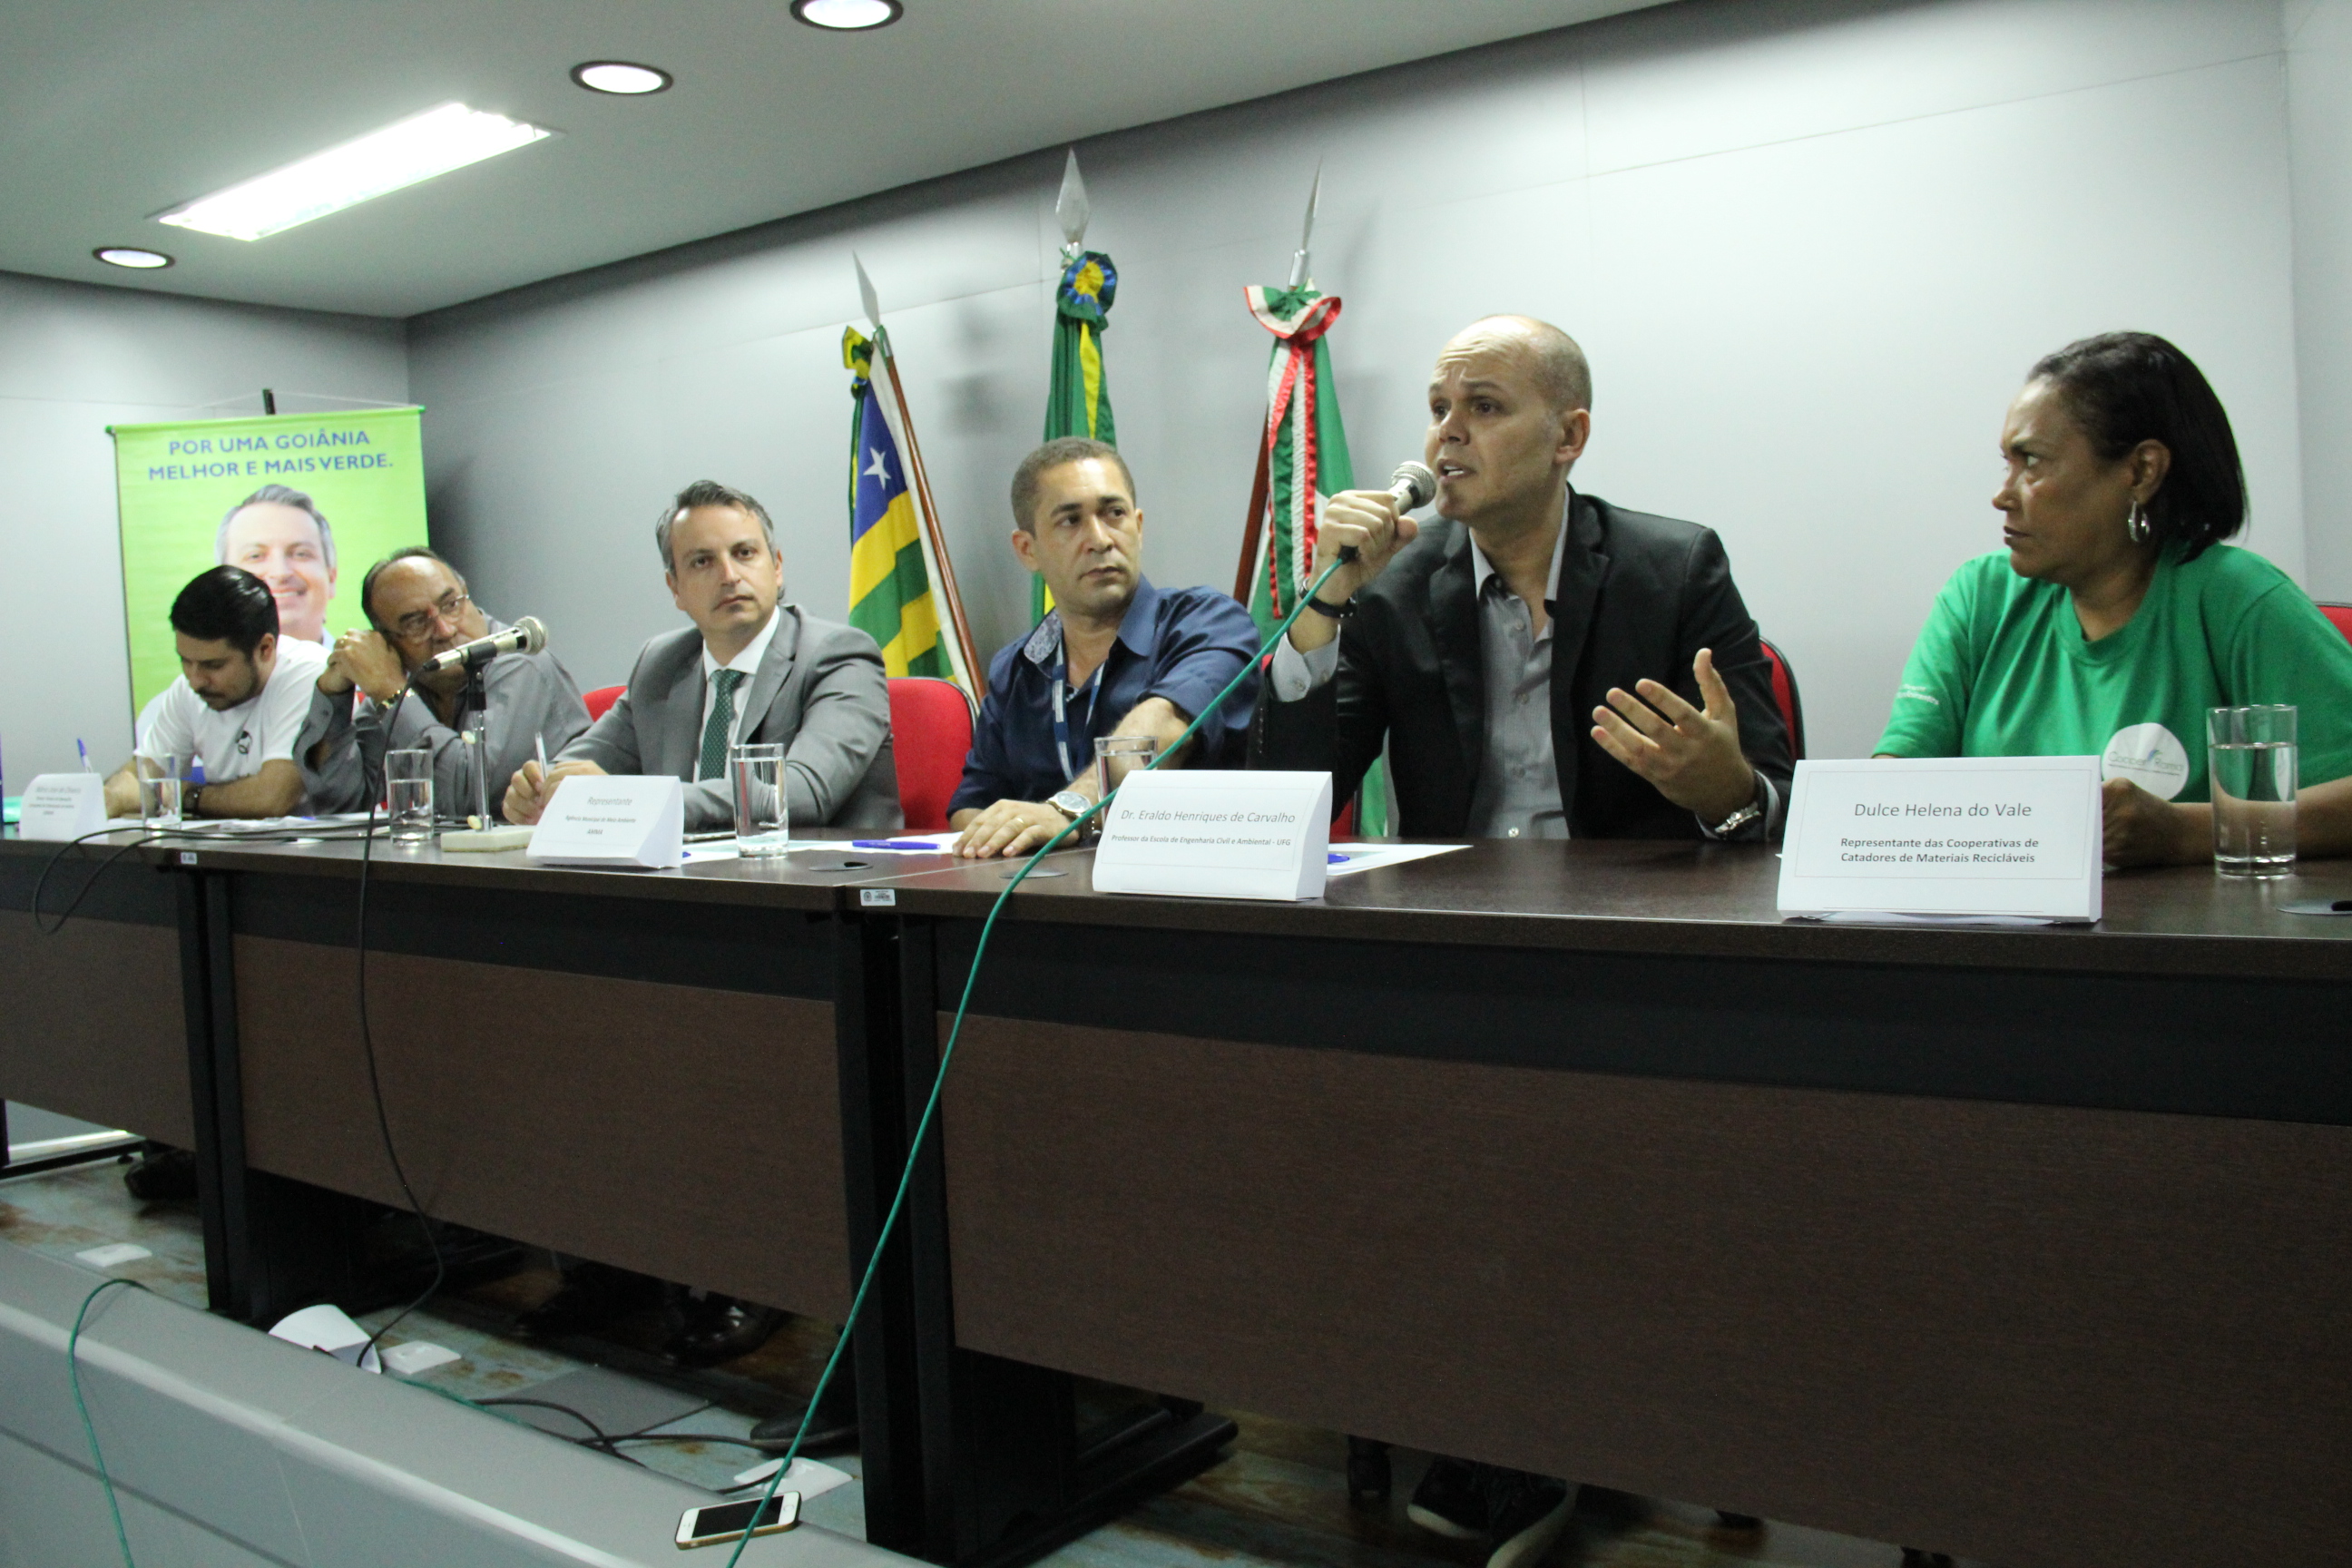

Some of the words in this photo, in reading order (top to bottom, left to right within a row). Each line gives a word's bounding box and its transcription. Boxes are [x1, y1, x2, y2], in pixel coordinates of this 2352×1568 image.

[169, 439, 213, 456] POR
[219, 436, 270, 453] UMA
[275, 427, 370, 449] GOIÂNIA
[148, 461, 240, 481] MELHOR
[246, 460, 258, 475] E
[264, 457, 316, 474] MAIS
[318, 453, 393, 470] VERDE.
[1121, 809, 1135, 819] Dr.
[1138, 809, 1171, 821] Eraldo
[1173, 810, 1228, 823] Henriques
[1230, 811, 1245, 822] de
[1247, 811, 1296, 823] Carvalho
[1854, 802, 1900, 817] Dulce
[1905, 802, 1963, 817] Helena
[1967, 802, 1990, 817] do
[1994, 802, 2033, 817] Vale
[1111, 834, 1141, 842] Professor
[1180, 837, 1215, 845] Engenharia
[1840, 838, 1922, 848] Representante
[1924, 838, 1944, 848] das
[1946, 838, 2022, 849] Cooperativas
[2024, 838, 2039, 848] de
[1840, 852, 1896, 862] Catadores
[1899, 853, 1914, 863] de
[1916, 853, 1969, 863] Materiais
[1972, 852, 2035, 863] Recicláveis
